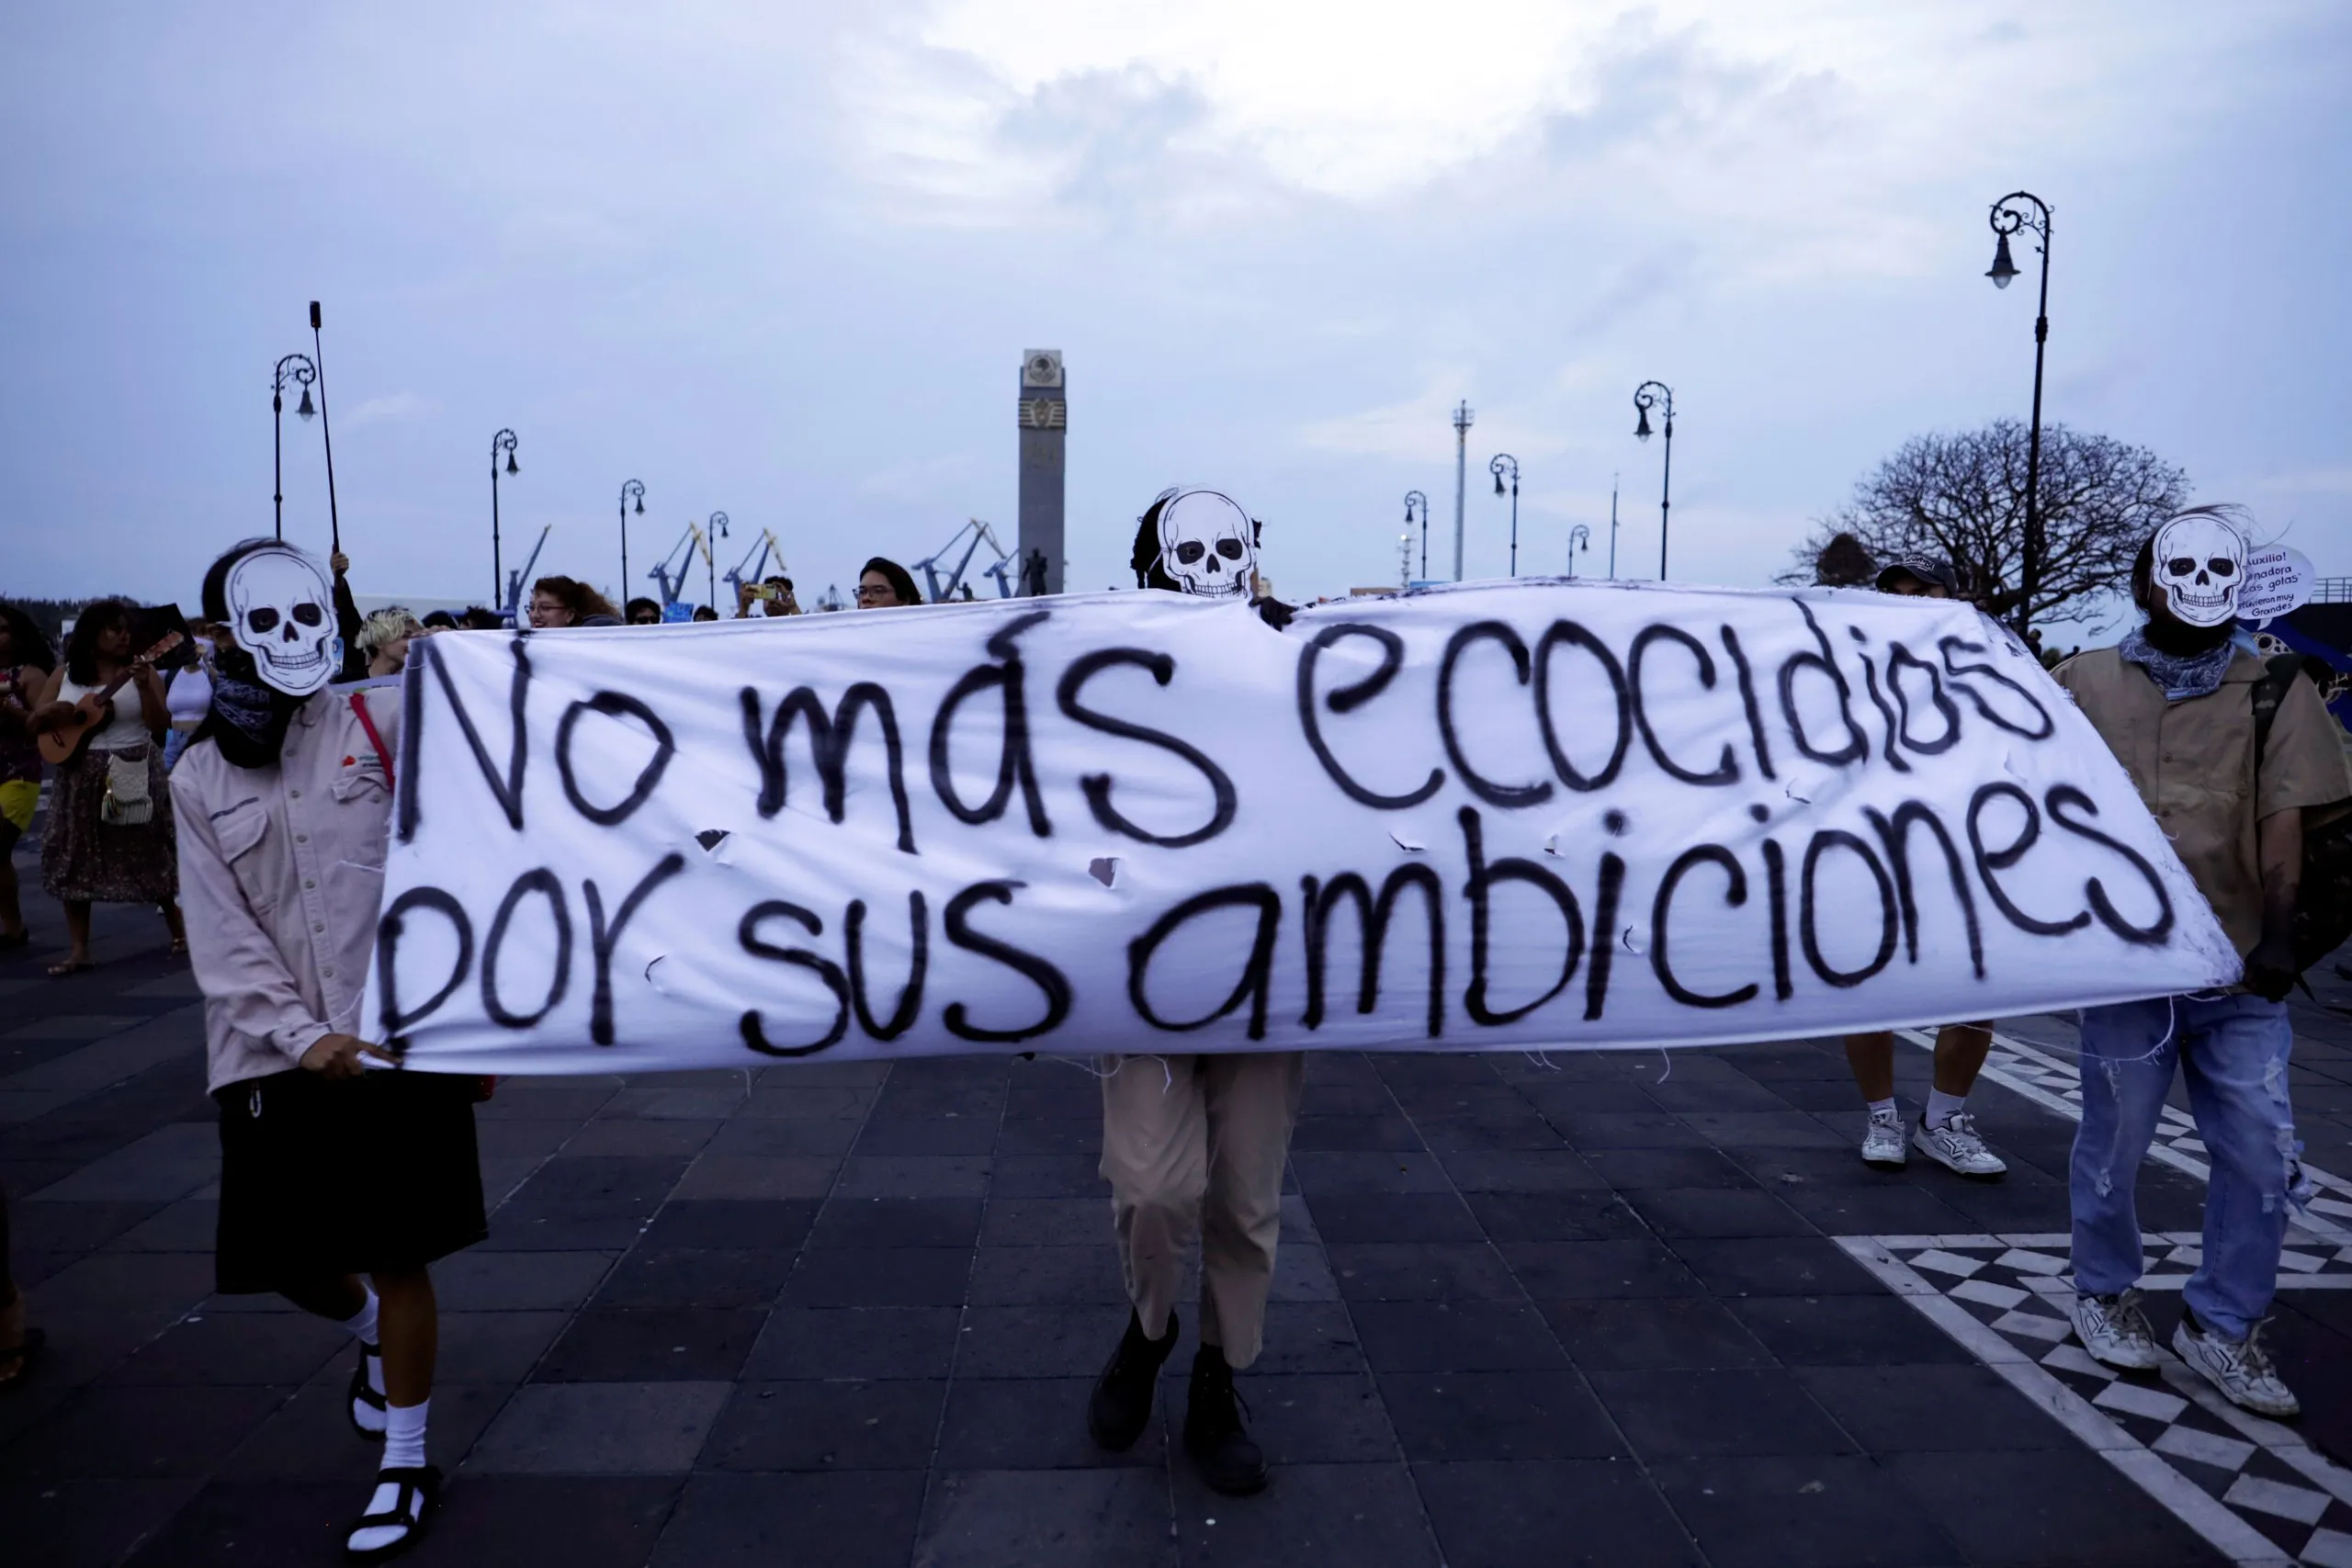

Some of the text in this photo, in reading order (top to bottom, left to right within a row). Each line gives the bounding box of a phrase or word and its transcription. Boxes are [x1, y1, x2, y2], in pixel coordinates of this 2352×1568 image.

[2252, 602, 2292, 616] Grandes
[2277, 593, 2294, 602] muy
[399, 597, 2055, 855] No más ecocidios
[739, 878, 1074, 1056] sus
[1127, 782, 2176, 1040] ambiciones
